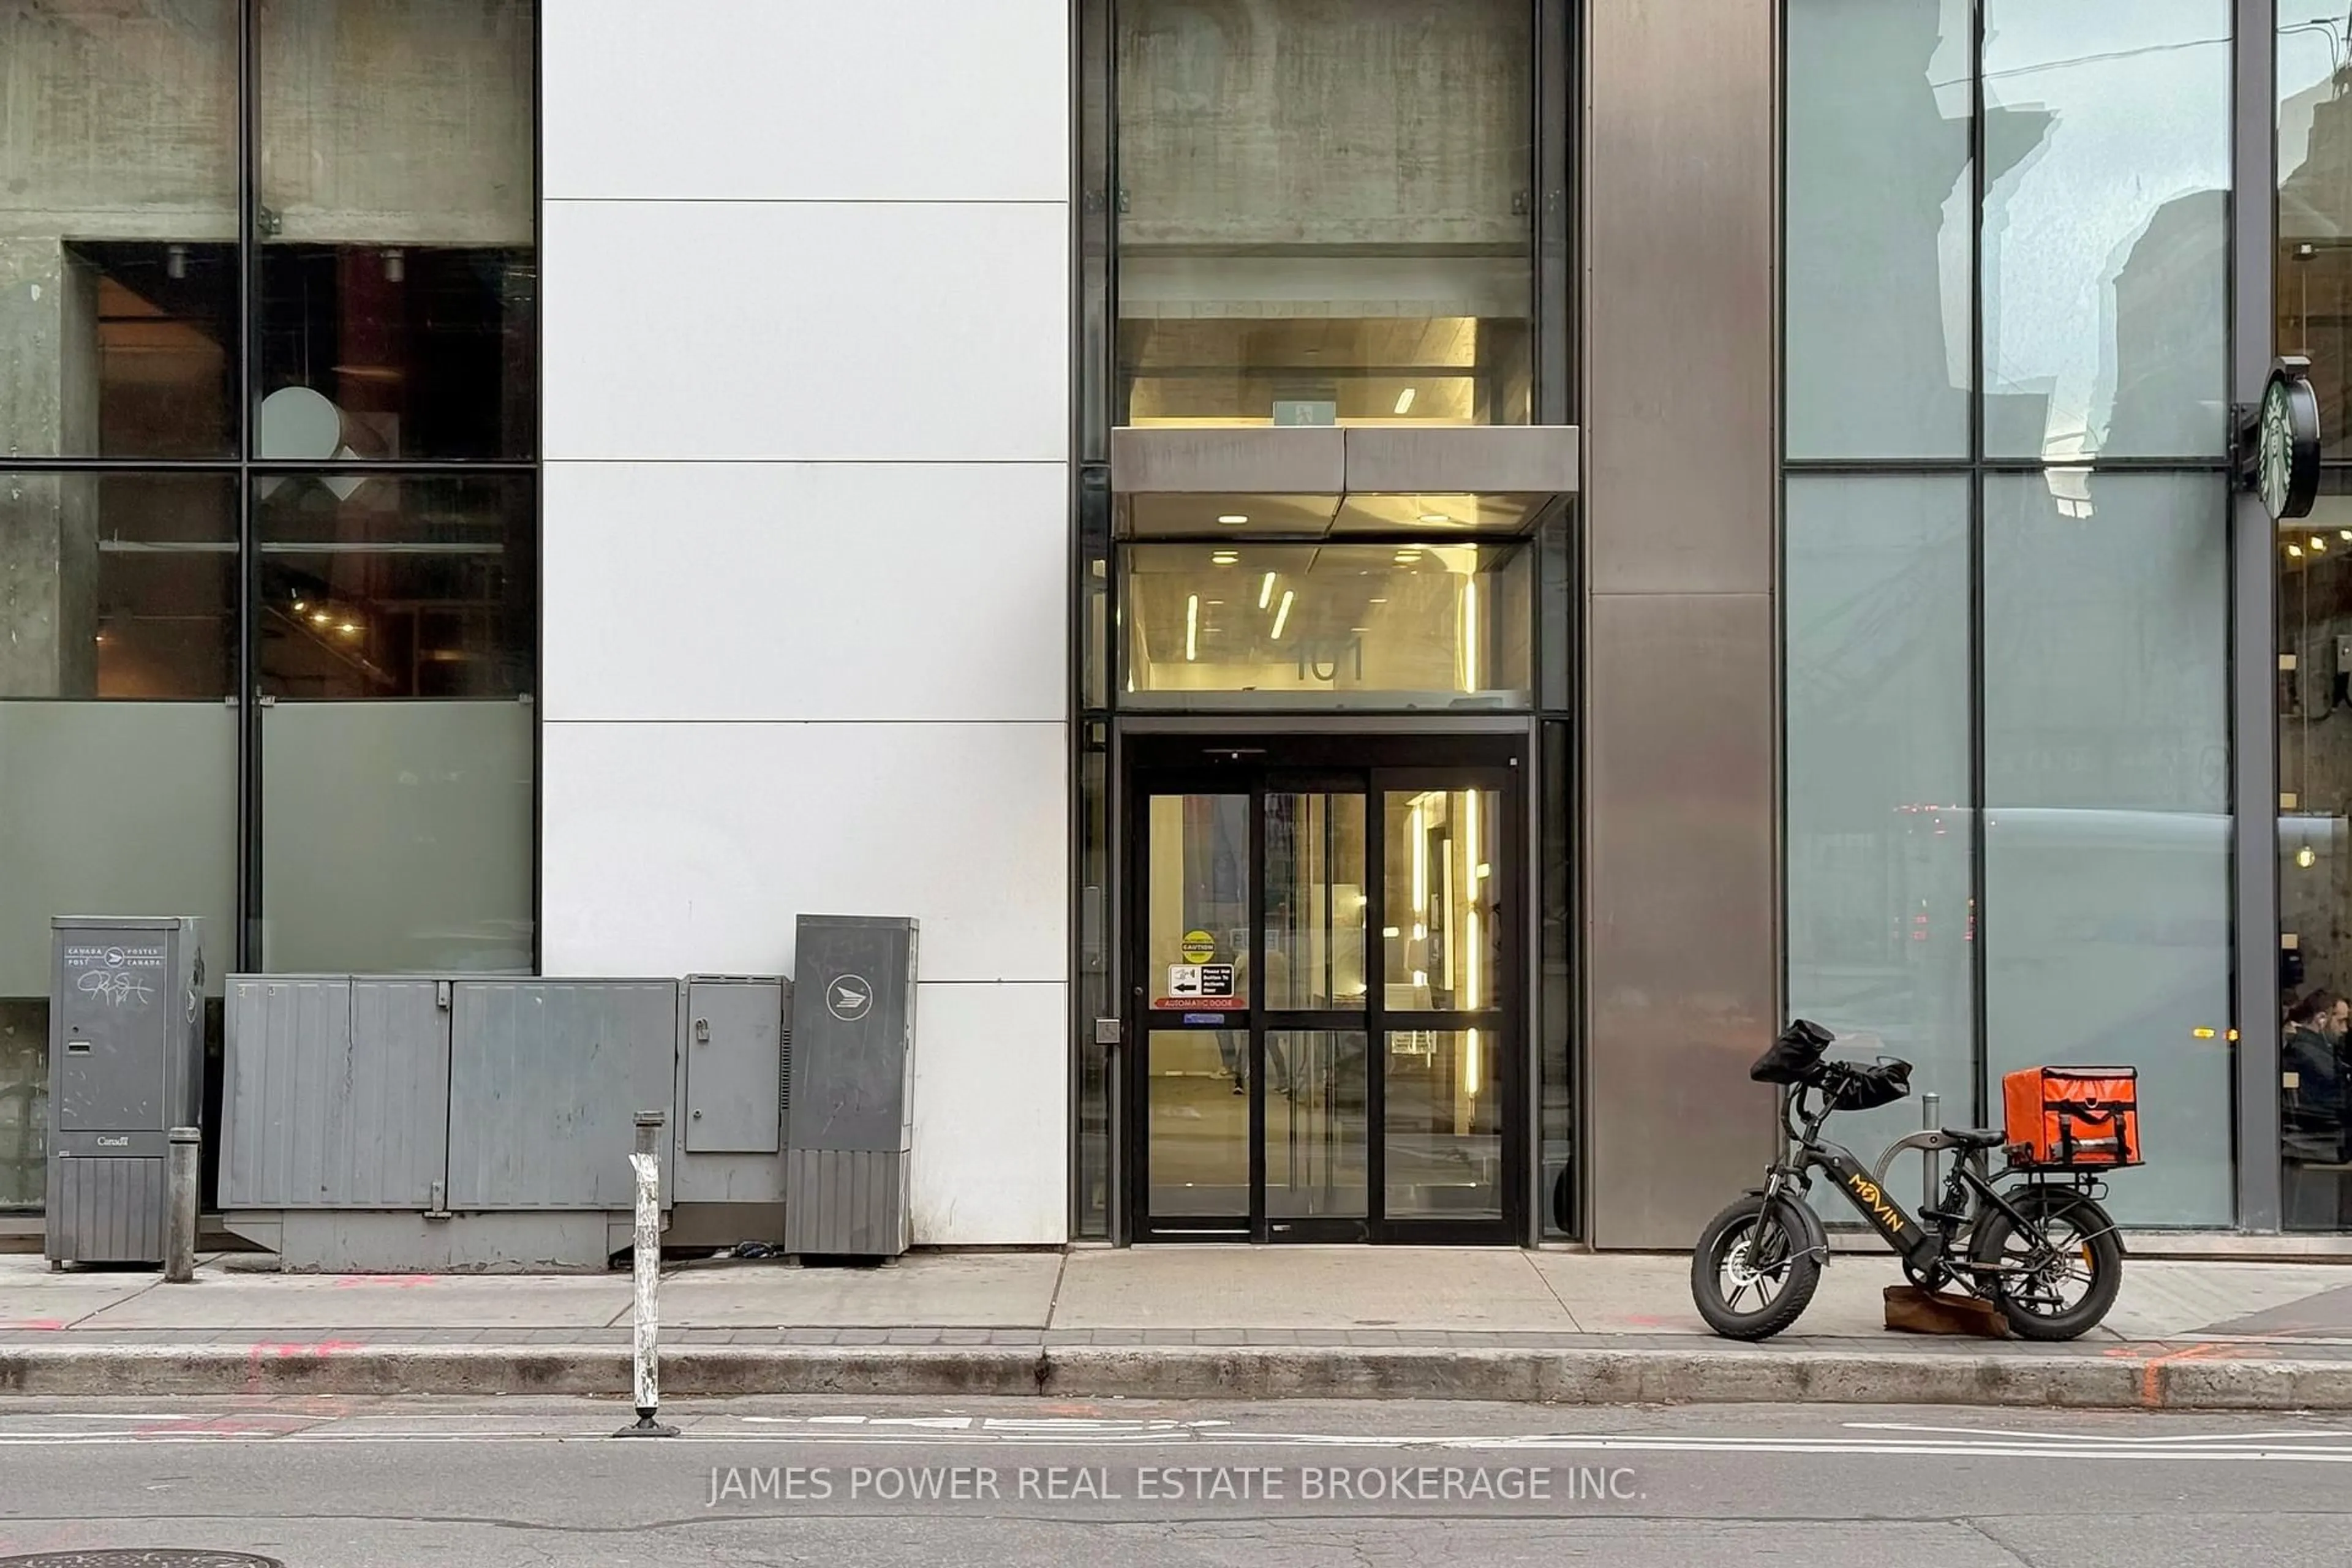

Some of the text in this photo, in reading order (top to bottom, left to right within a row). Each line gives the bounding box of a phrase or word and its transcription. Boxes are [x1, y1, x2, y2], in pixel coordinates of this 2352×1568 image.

[1289, 636, 1362, 680] 101
[1210, 999, 1232, 1008] DOOR
[1849, 1173, 1904, 1232] MOVIN
